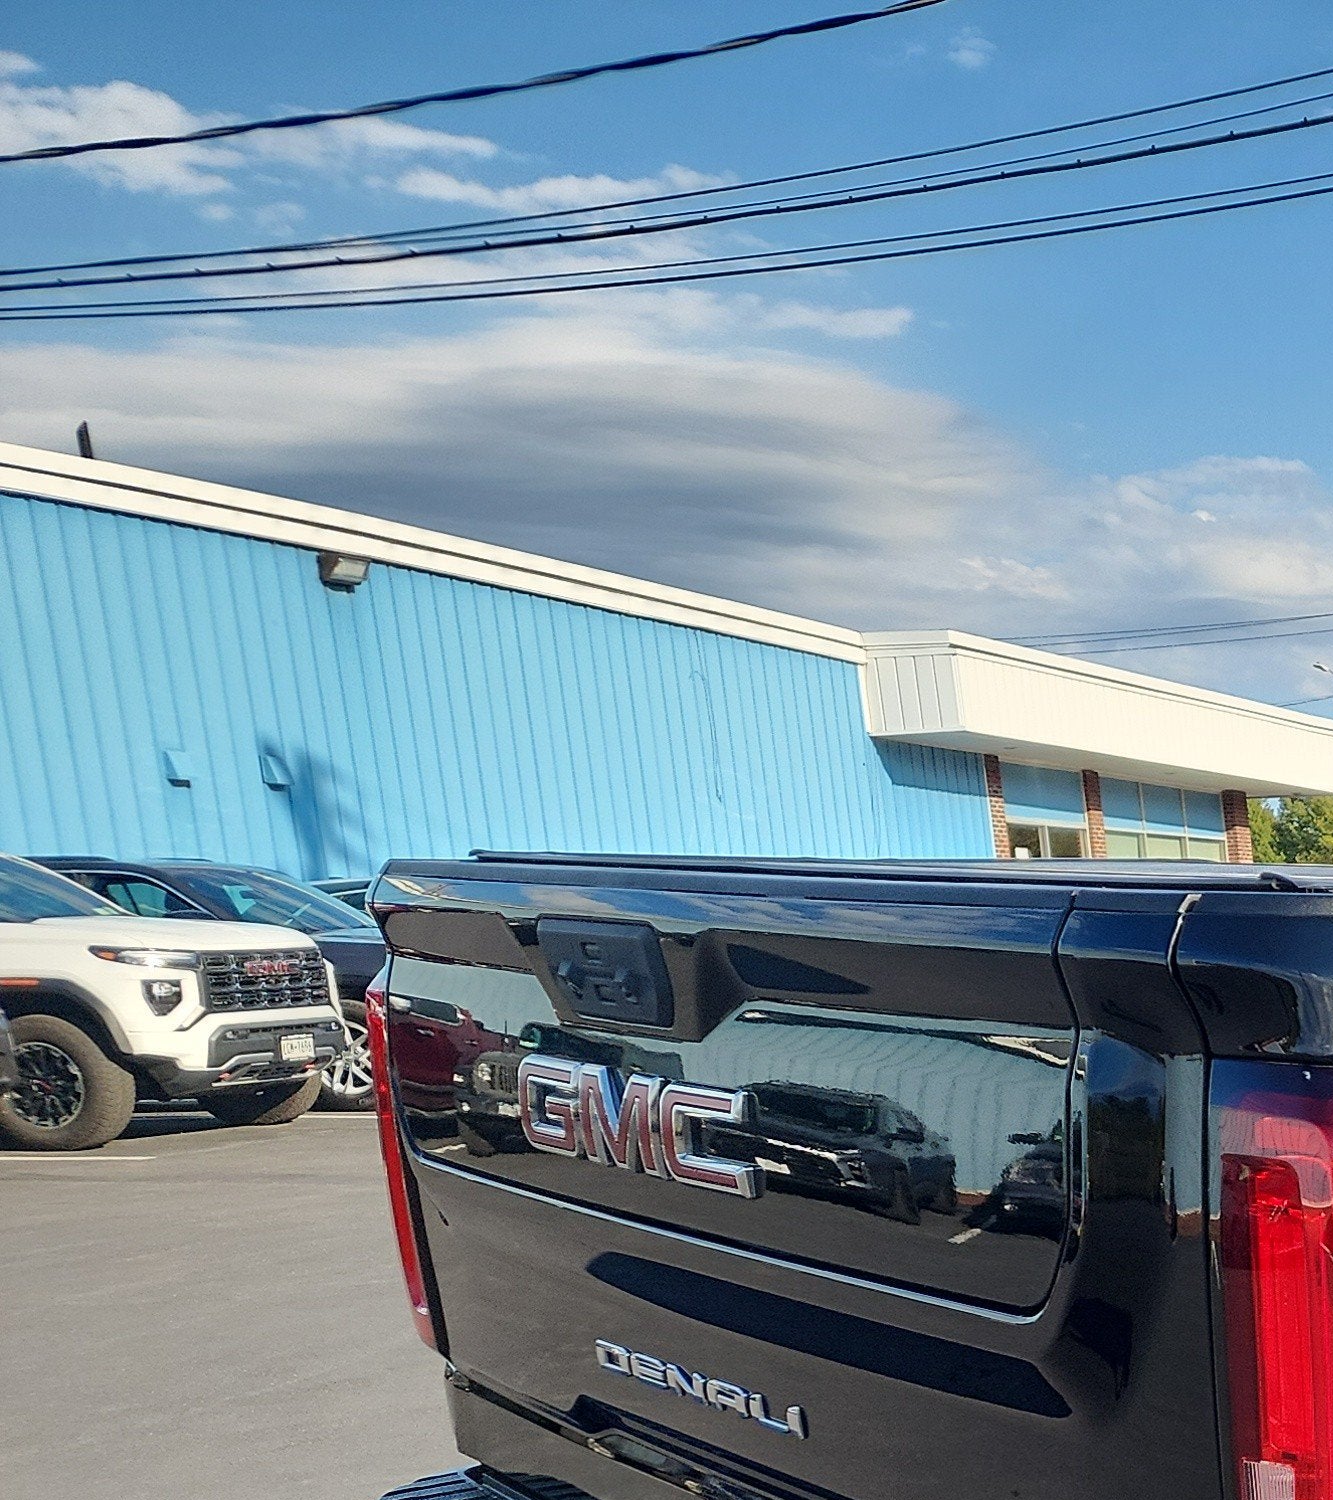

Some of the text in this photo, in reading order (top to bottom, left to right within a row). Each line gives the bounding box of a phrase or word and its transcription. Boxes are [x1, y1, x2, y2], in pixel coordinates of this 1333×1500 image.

[243, 958, 301, 977] GMC
[518, 1053, 760, 1199] GMC
[594, 1337, 808, 1440] DENALI
